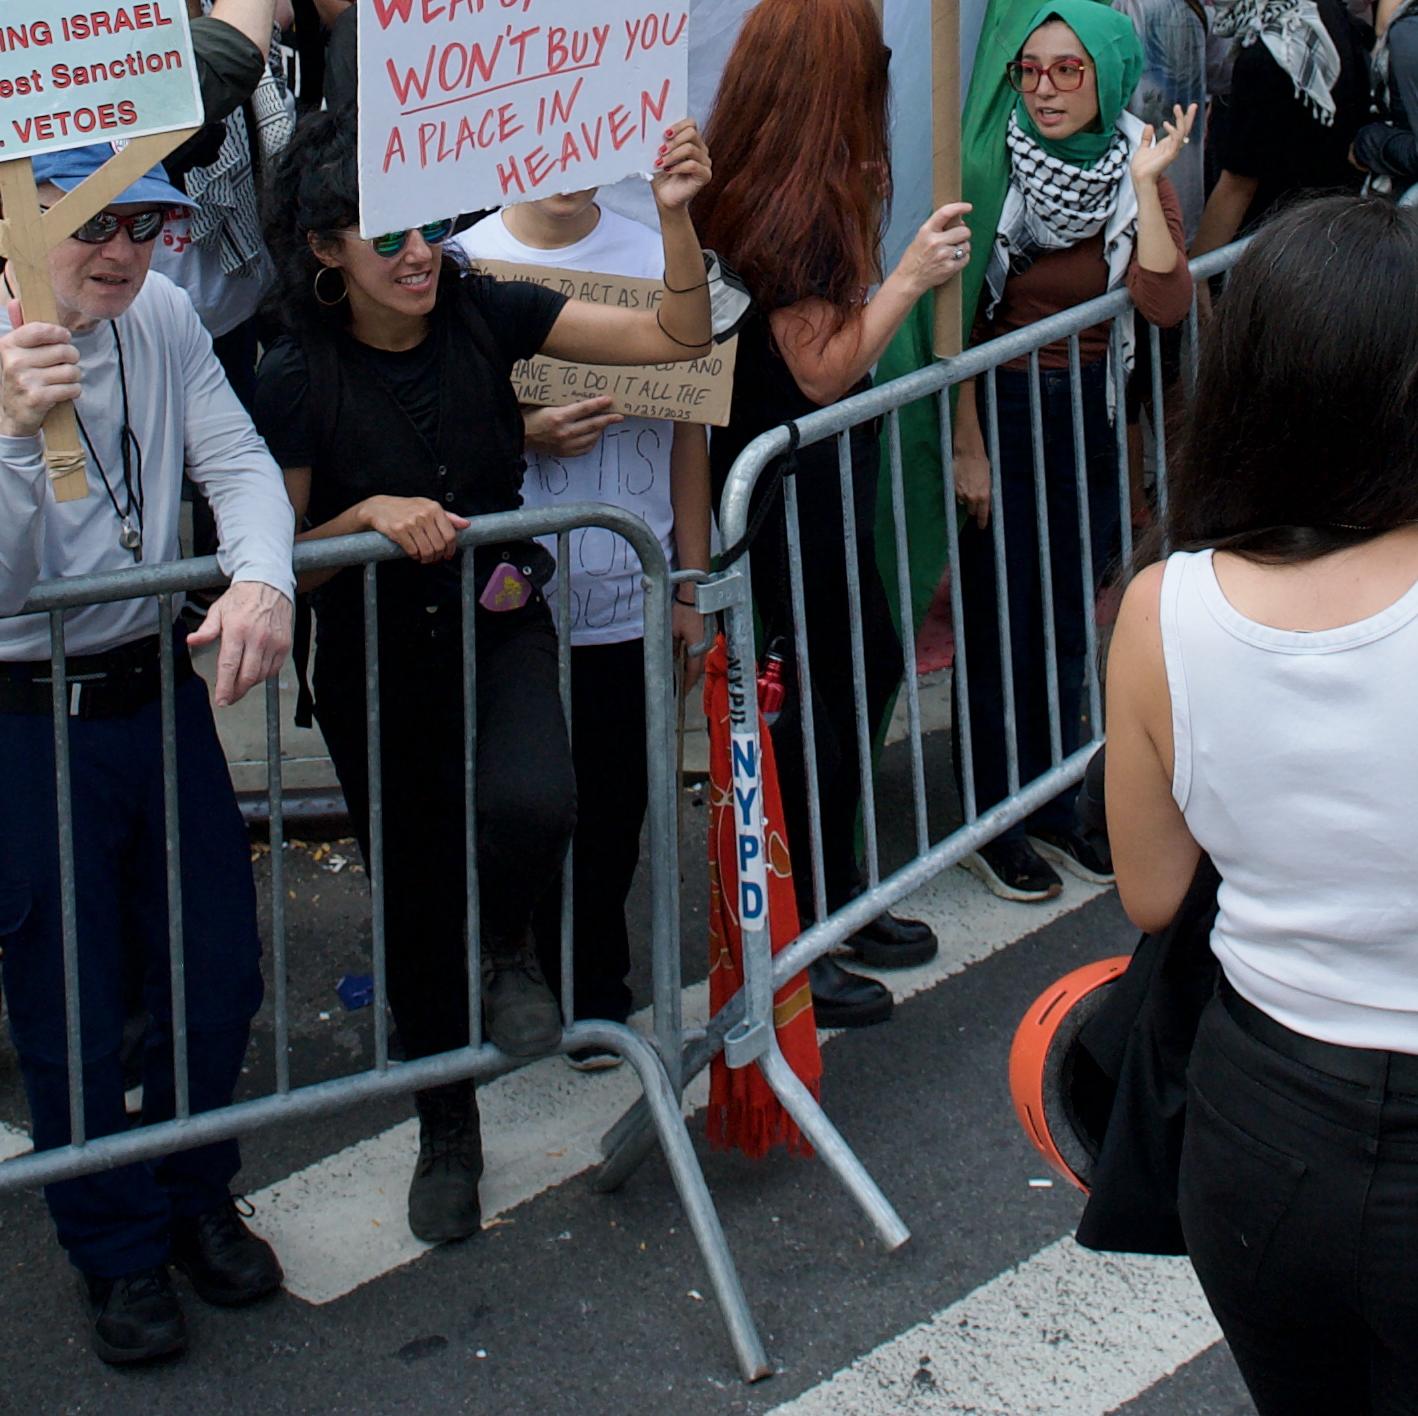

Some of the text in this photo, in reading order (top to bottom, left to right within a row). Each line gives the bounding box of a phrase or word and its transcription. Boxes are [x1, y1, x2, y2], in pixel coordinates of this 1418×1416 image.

[61, 2, 173, 42] ISRAEL
[51, 48, 183, 88] Sanction
[386, 11, 688, 106] WON'T BUY YOU
[12, 100, 138, 143] VETOES
[383, 76, 584, 174] A PLACE IN
[496, 78, 671, 195] HEAVEN
[579, 282, 613, 304] ACT
[617, 289, 640, 309] AS
[646, 290, 663, 309] IF
[559, 367, 577, 386] TO
[584, 370, 608, 391] DO
[639, 381, 672, 401] ALL
[677, 384, 711, 406] THE
[688, 358, 723, 376] AND
[624, 402, 692, 420] 9/23/2025
[732, 739, 764, 921] NYPD
